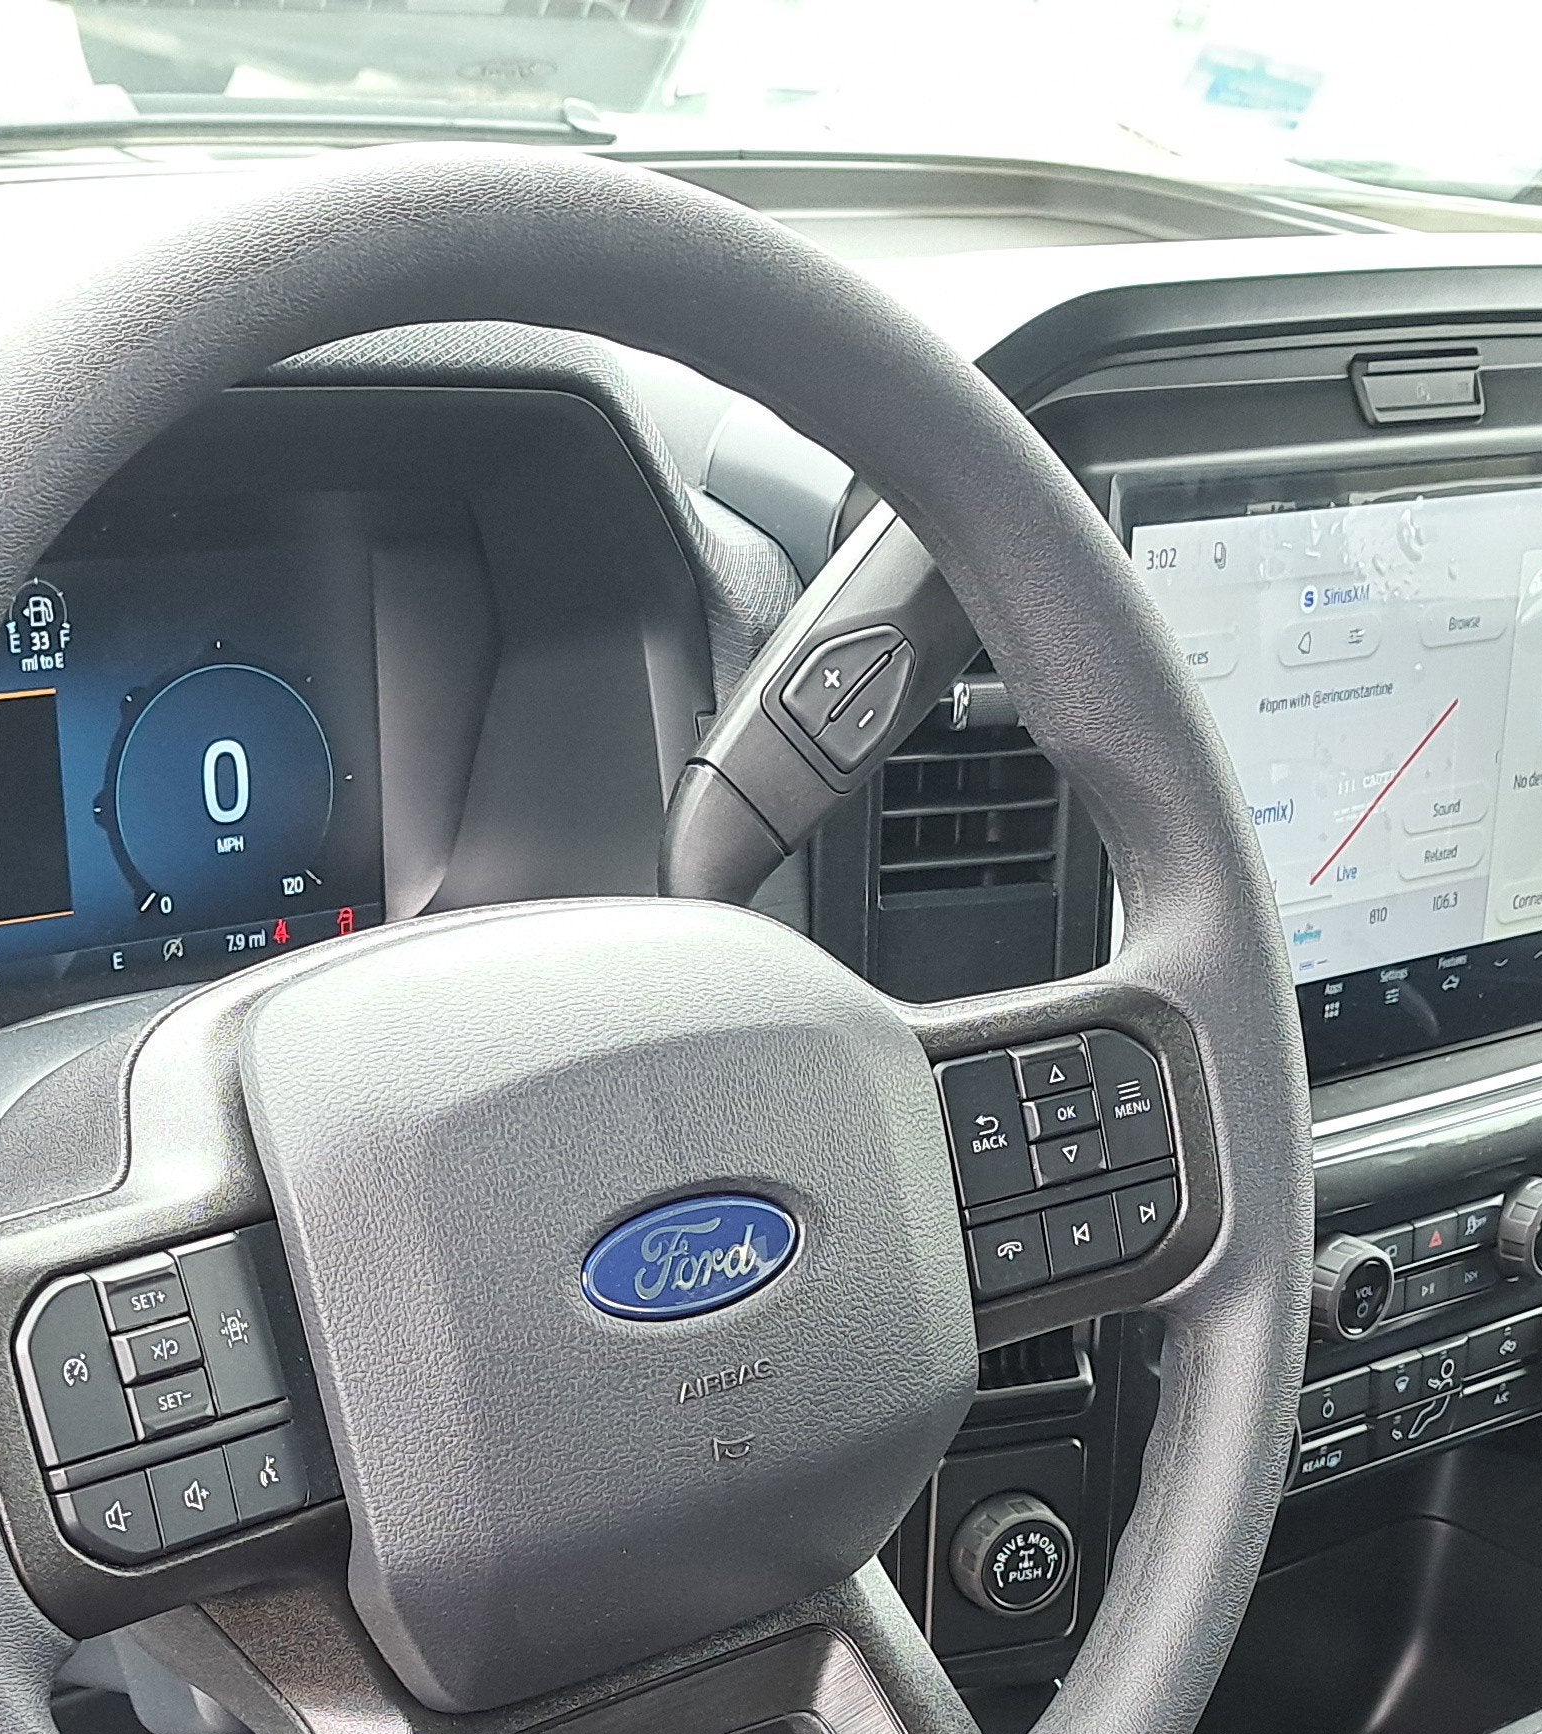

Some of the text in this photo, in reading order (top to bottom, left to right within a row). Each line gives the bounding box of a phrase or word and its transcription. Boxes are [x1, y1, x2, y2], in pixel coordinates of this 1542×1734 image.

[1145, 547, 1178, 571] 3:02
[1322, 584, 1371, 606] SiriusXM
[9, 633, 21, 654] E
[30, 630, 50, 651] 33
[59, 629, 70, 649] F
[54, 651, 65, 669] E
[1289, 693, 1311, 710] with
[202, 738, 250, 825] 0
[1513, 774, 1528, 790] No
[1432, 799, 1461, 818] Sound
[215, 835, 245, 854] MPH
[1423, 845, 1458, 864] Related
[1336, 865, 1358, 882] Live
[281, 876, 305, 896] 120
[160, 896, 172, 914] 0
[1432, 892, 1458, 912] 106.3
[1368, 906, 1388, 925] 810
[225, 934, 247, 953] 7.9
[112, 951, 126, 971] E
[1057, 1105, 1077, 1122] OK
[1114, 1098, 1151, 1120] MENU
[971, 1133, 1008, 1154] BACK
[634, 1216, 757, 1301] Ford
[130, 1290, 167, 1312] SET+
[677, 1357, 774, 1405] AIRBAG
[993, 1531, 1059, 1574] DRIVE MODE
[1008, 1566, 1043, 1583] PUSH
